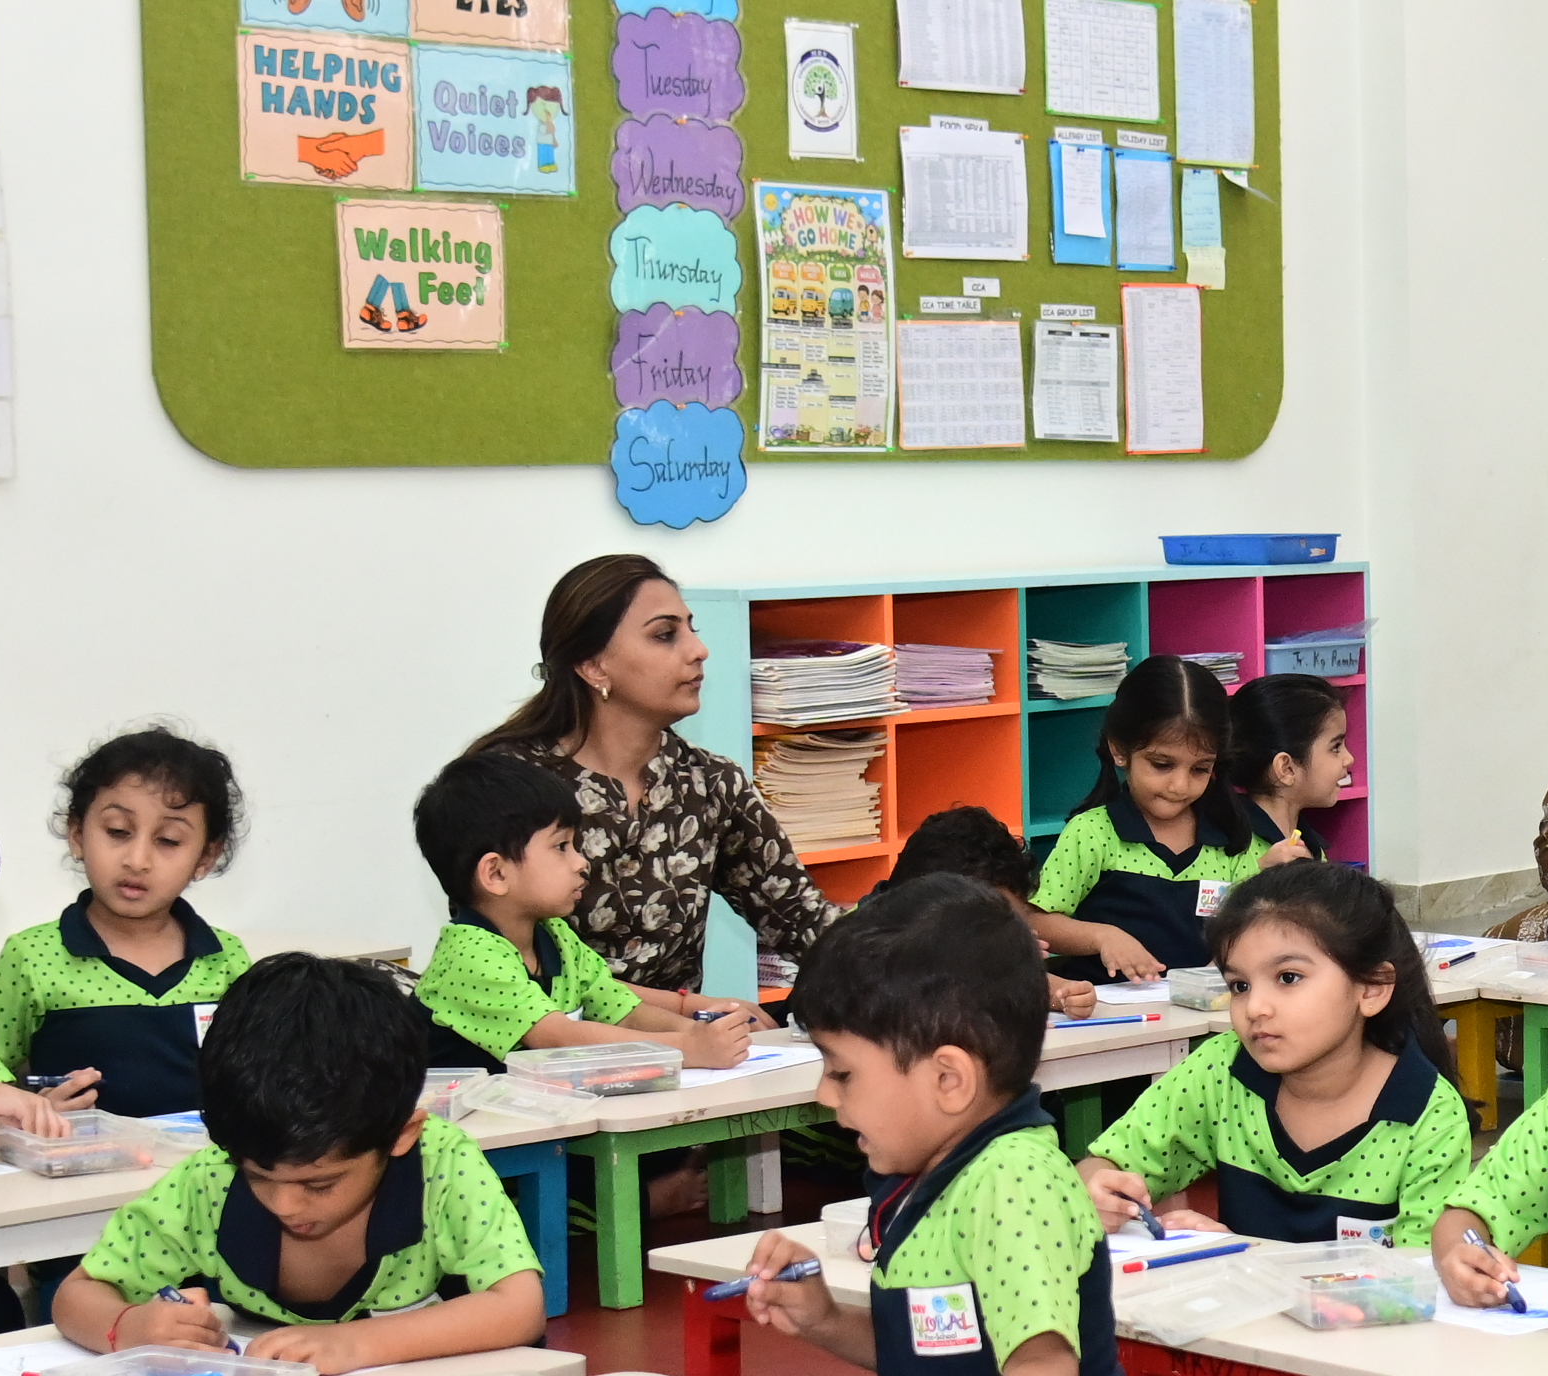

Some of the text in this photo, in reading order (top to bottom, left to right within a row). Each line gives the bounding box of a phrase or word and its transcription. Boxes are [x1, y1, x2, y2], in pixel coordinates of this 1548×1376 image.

[254, 44, 402, 93] HELPING
[632, 40, 712, 118] Tuesday
[261, 82, 376, 125] HANDS
[433, 80, 519, 118] Quiet
[428, 119, 526, 159] Voices
[1086, 133, 1101, 142] LIST
[1119, 135, 1165, 146] HOLIDAY LIST
[627, 145, 738, 217] Wednesday
[793, 206, 856, 229] HOW WE
[354, 227, 493, 274] Walking
[797, 227, 857, 250] GO HOME
[624, 235, 723, 302] Thursday
[418, 272, 487, 306] Feet
[938, 301, 954, 309] TIME
[957, 301, 978, 309] TABLE
[972, 284, 986, 292] CCA
[1043, 309, 1055, 317] CCA
[1079, 309, 1094, 317] LIST
[631, 334, 711, 402] Friday
[629, 435, 732, 499] Saturday
[1341, 1229, 1362, 1237] MRV
